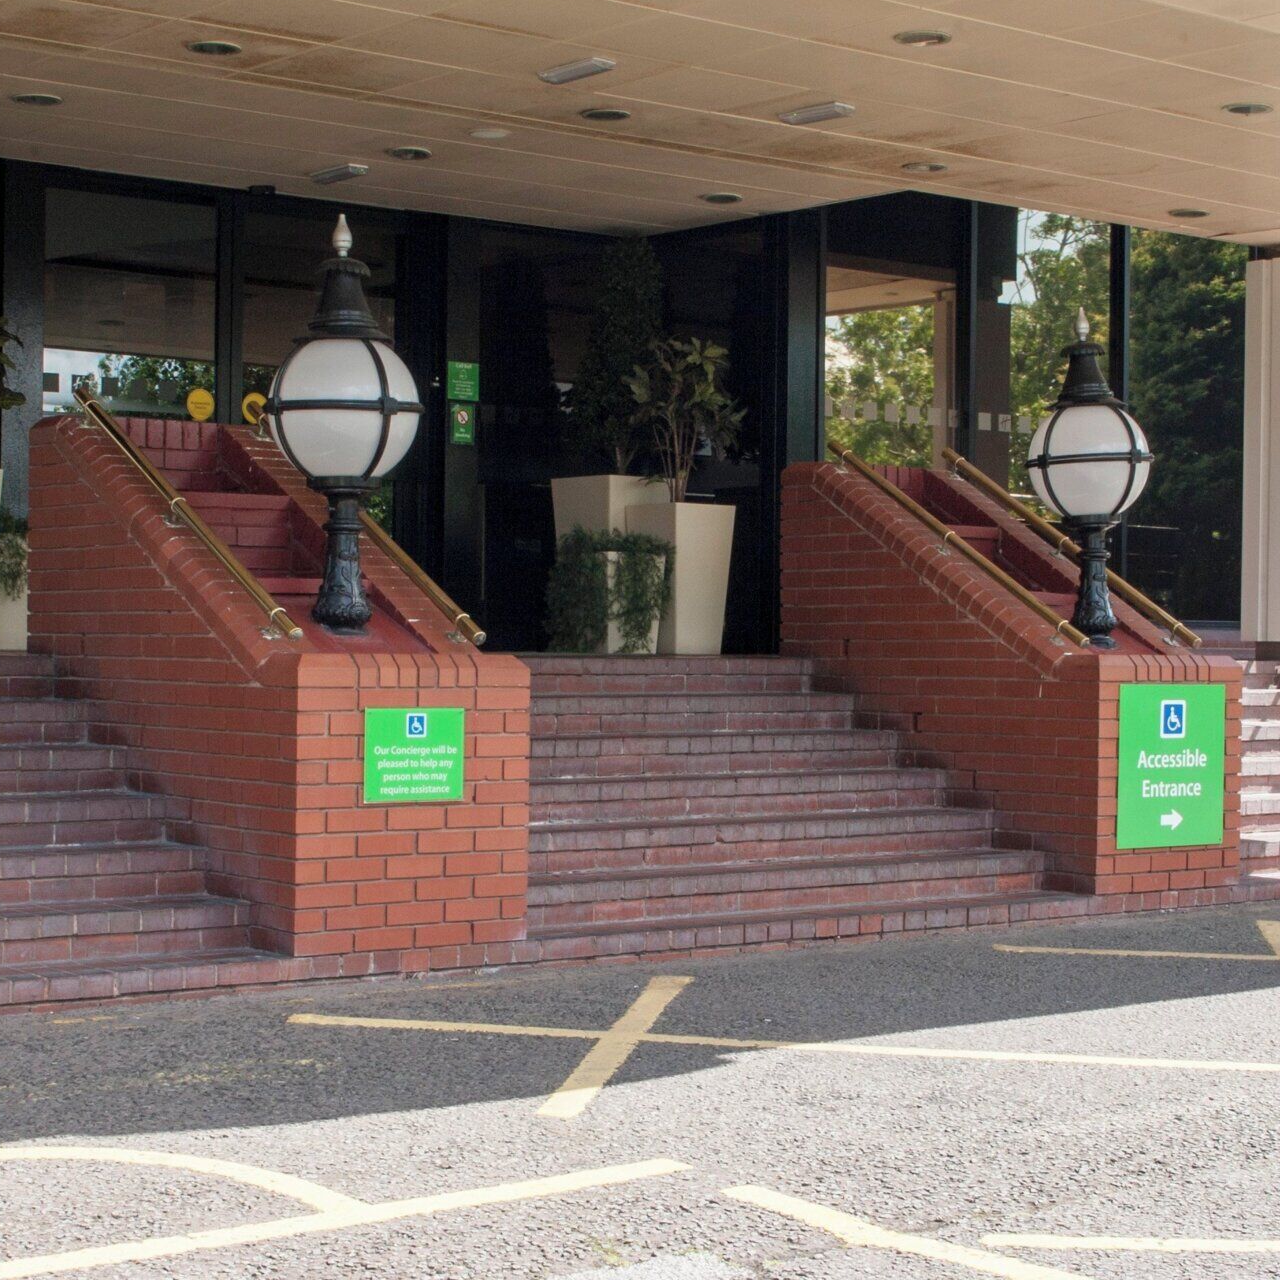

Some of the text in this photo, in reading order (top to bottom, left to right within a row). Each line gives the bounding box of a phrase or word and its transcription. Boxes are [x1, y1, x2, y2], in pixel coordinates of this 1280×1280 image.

[374, 745, 458, 756] Our Concierge will be
[1137, 748, 1207, 769] Accessible
[377, 759, 453, 770] pleased to help any
[383, 772, 448, 783] person who may
[380, 785, 450, 796] require assistance
[1142, 779, 1202, 798] Entrance
